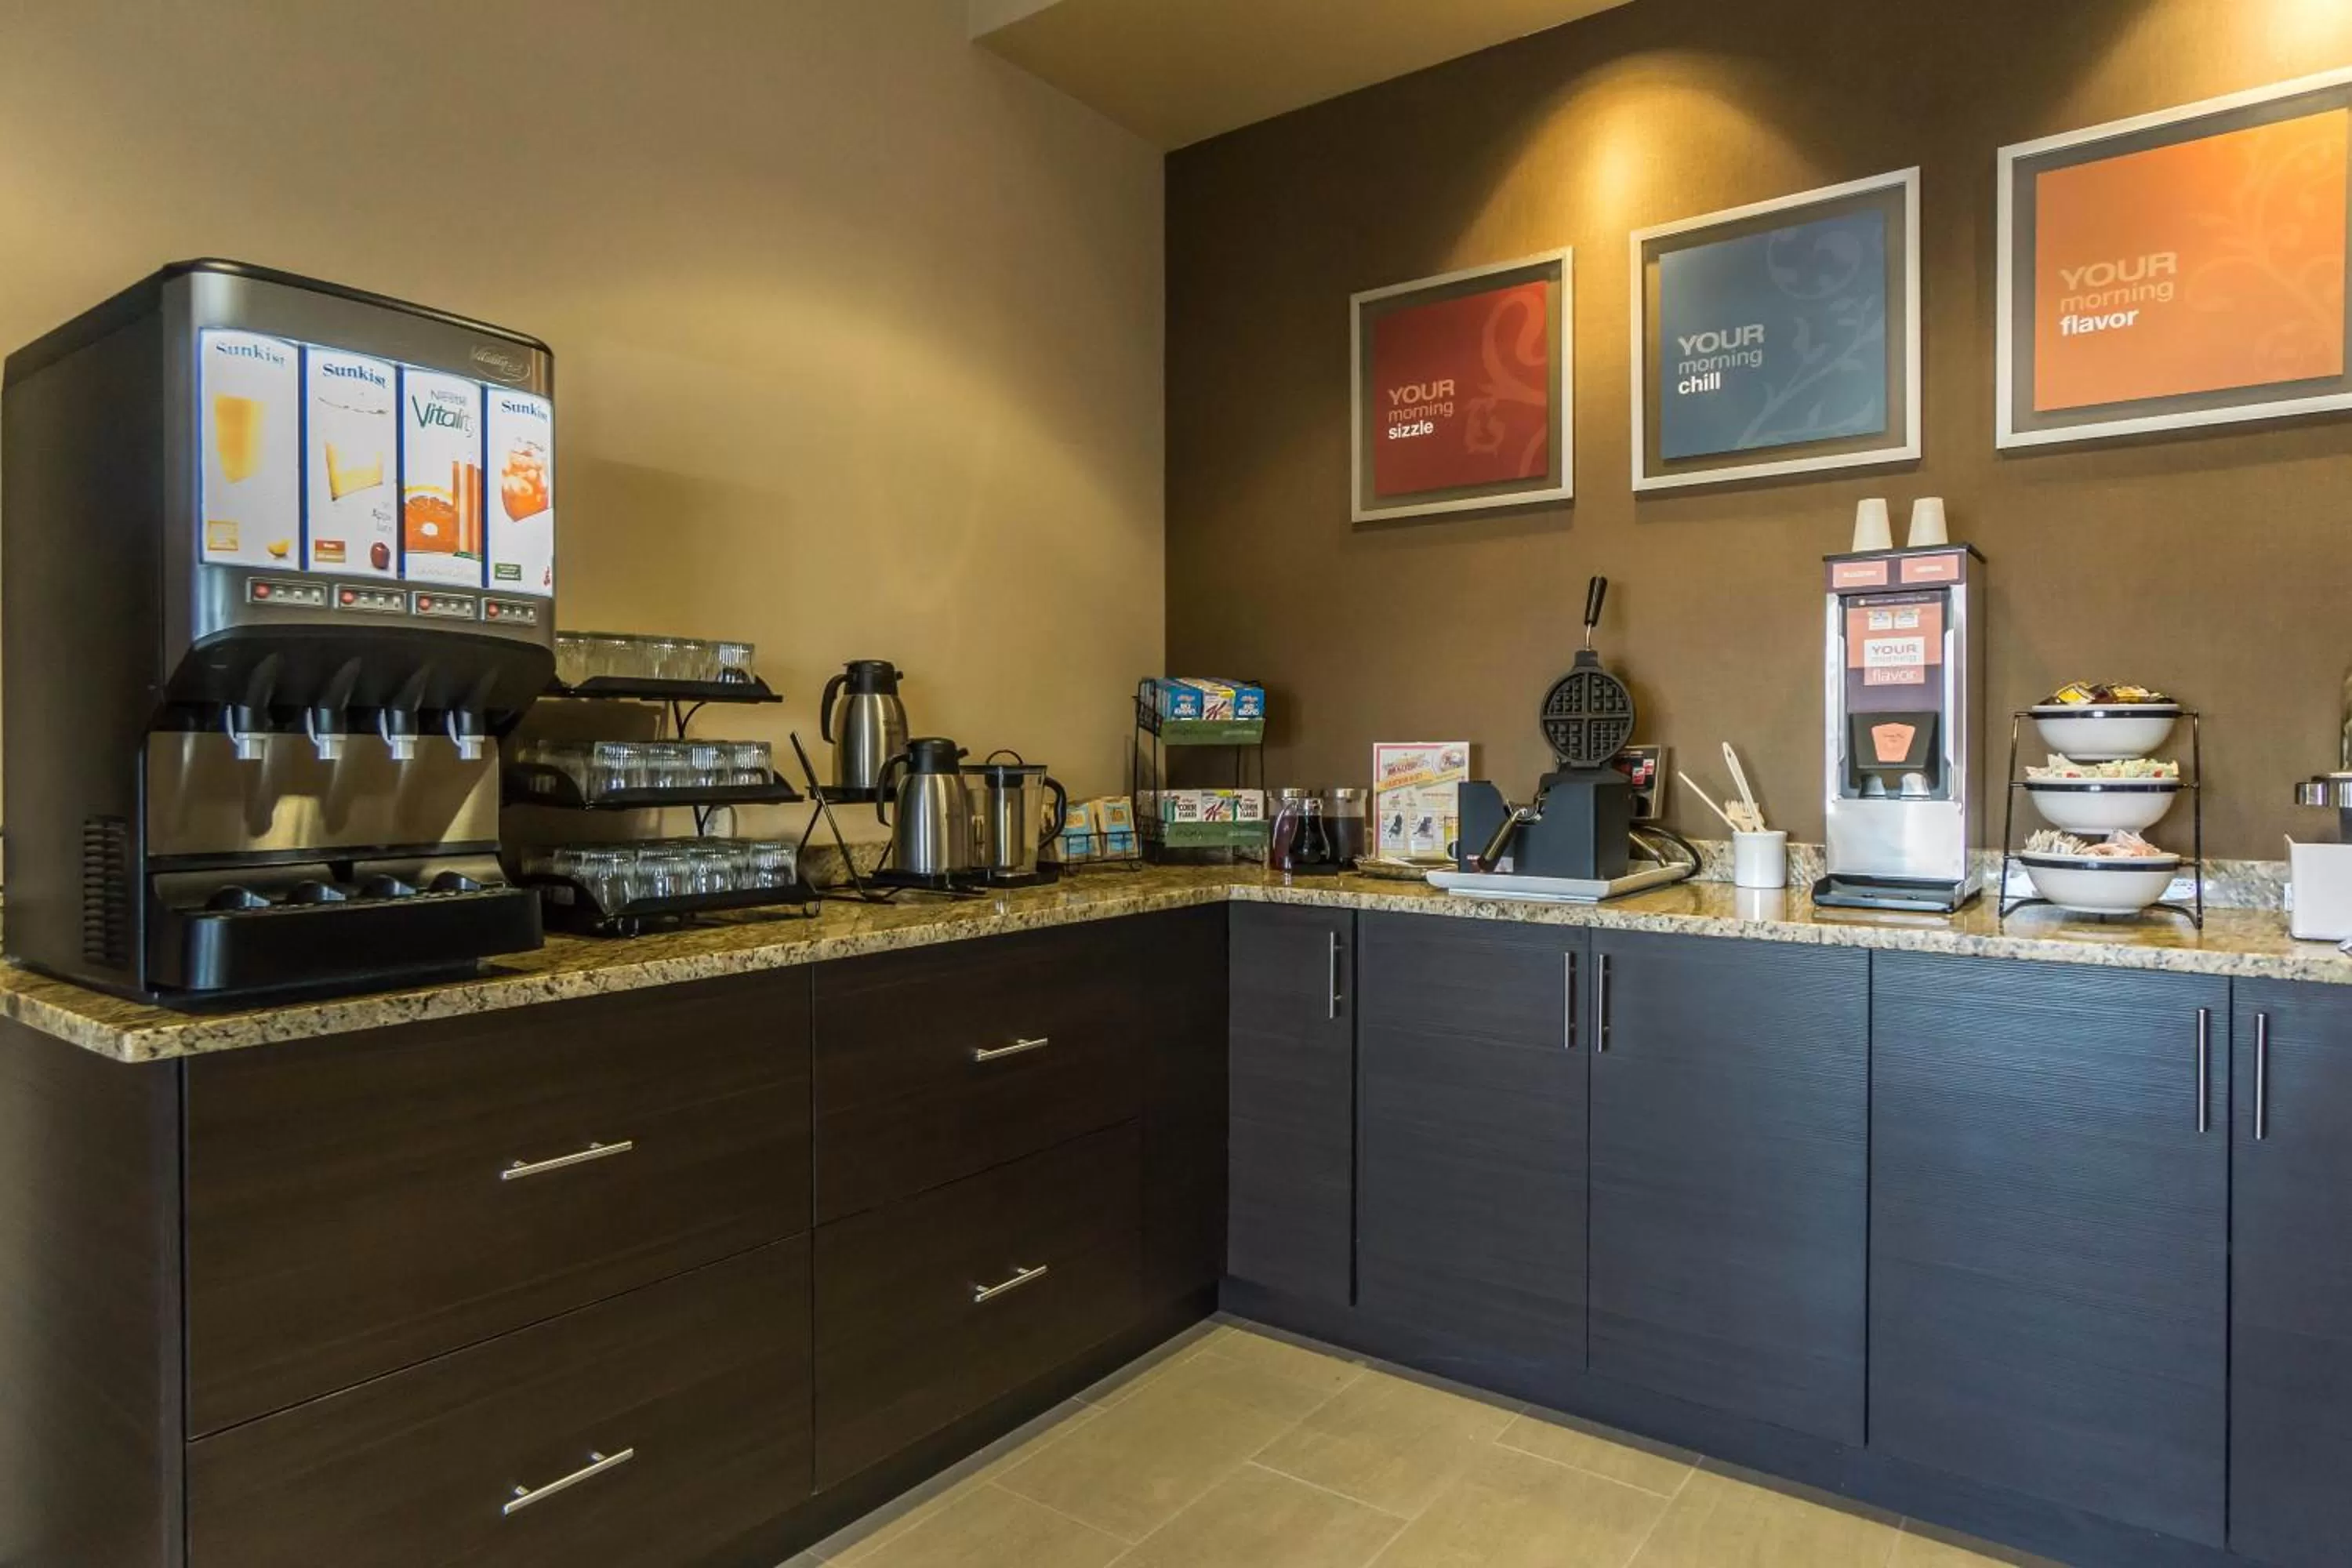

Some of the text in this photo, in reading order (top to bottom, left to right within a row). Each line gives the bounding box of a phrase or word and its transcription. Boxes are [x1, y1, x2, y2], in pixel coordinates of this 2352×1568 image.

[2059, 251, 2178, 291] YOUR
[2060, 281, 2174, 313] morning
[2060, 309, 2140, 336] flavor
[1678, 324, 1765, 355] YOUR
[1678, 348, 1762, 376] morning
[322, 363, 387, 389] Sunkist
[1678, 372, 1721, 394] chill
[1388, 379, 1455, 405] YOUR
[1388, 401, 1454, 423] morning
[1388, 419, 1434, 440] sizzle
[1871, 644, 1918, 655] YOUR
[1871, 669, 1918, 682] flavor
